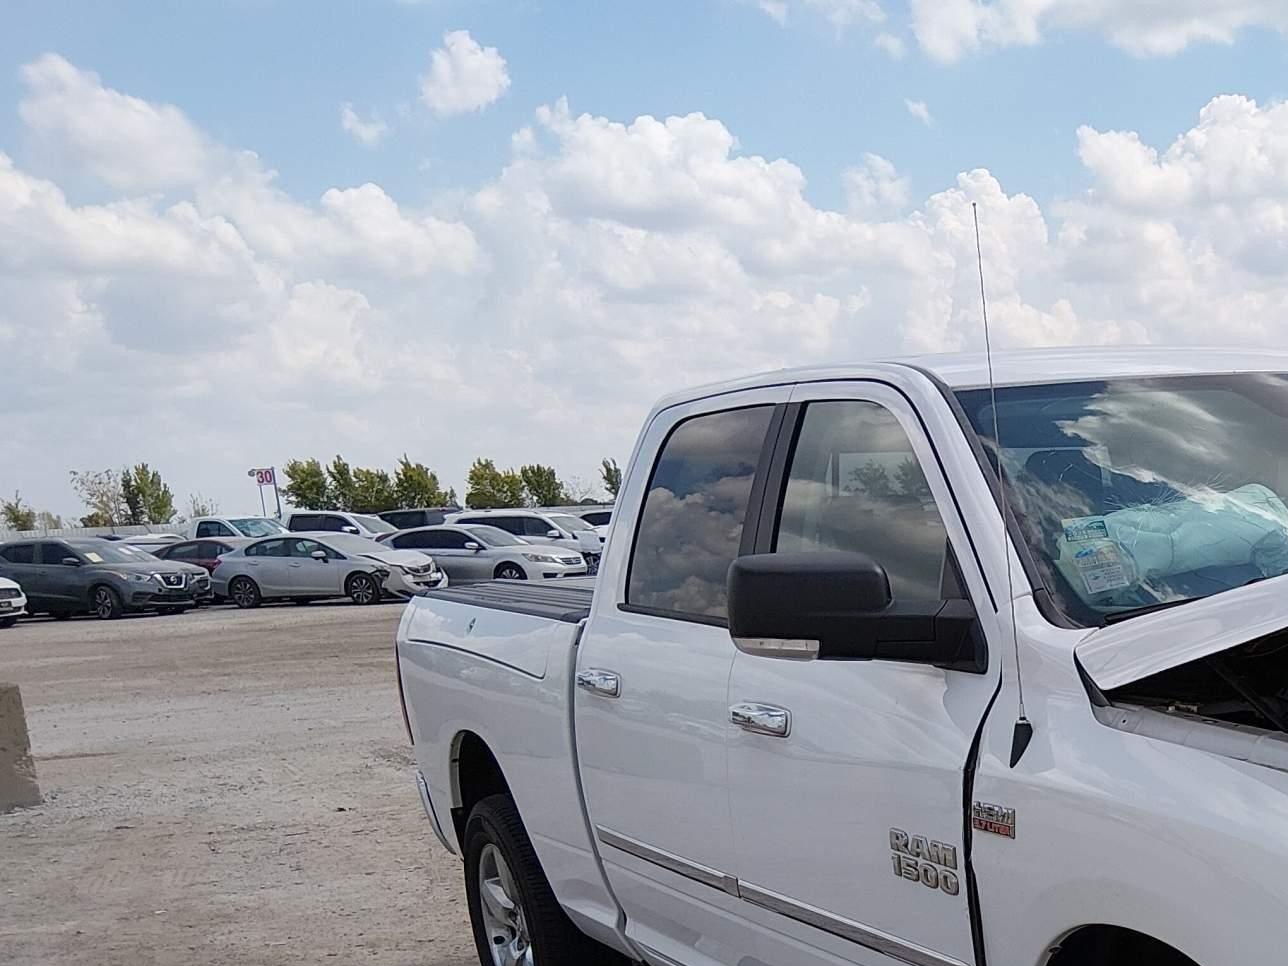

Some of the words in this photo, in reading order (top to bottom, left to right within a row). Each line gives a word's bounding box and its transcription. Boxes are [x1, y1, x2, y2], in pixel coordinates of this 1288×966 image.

[256, 470, 273, 484] 30
[973, 801, 1016, 826] HEMI
[890, 827, 957, 870] RAM
[892, 853, 959, 896] 1500
